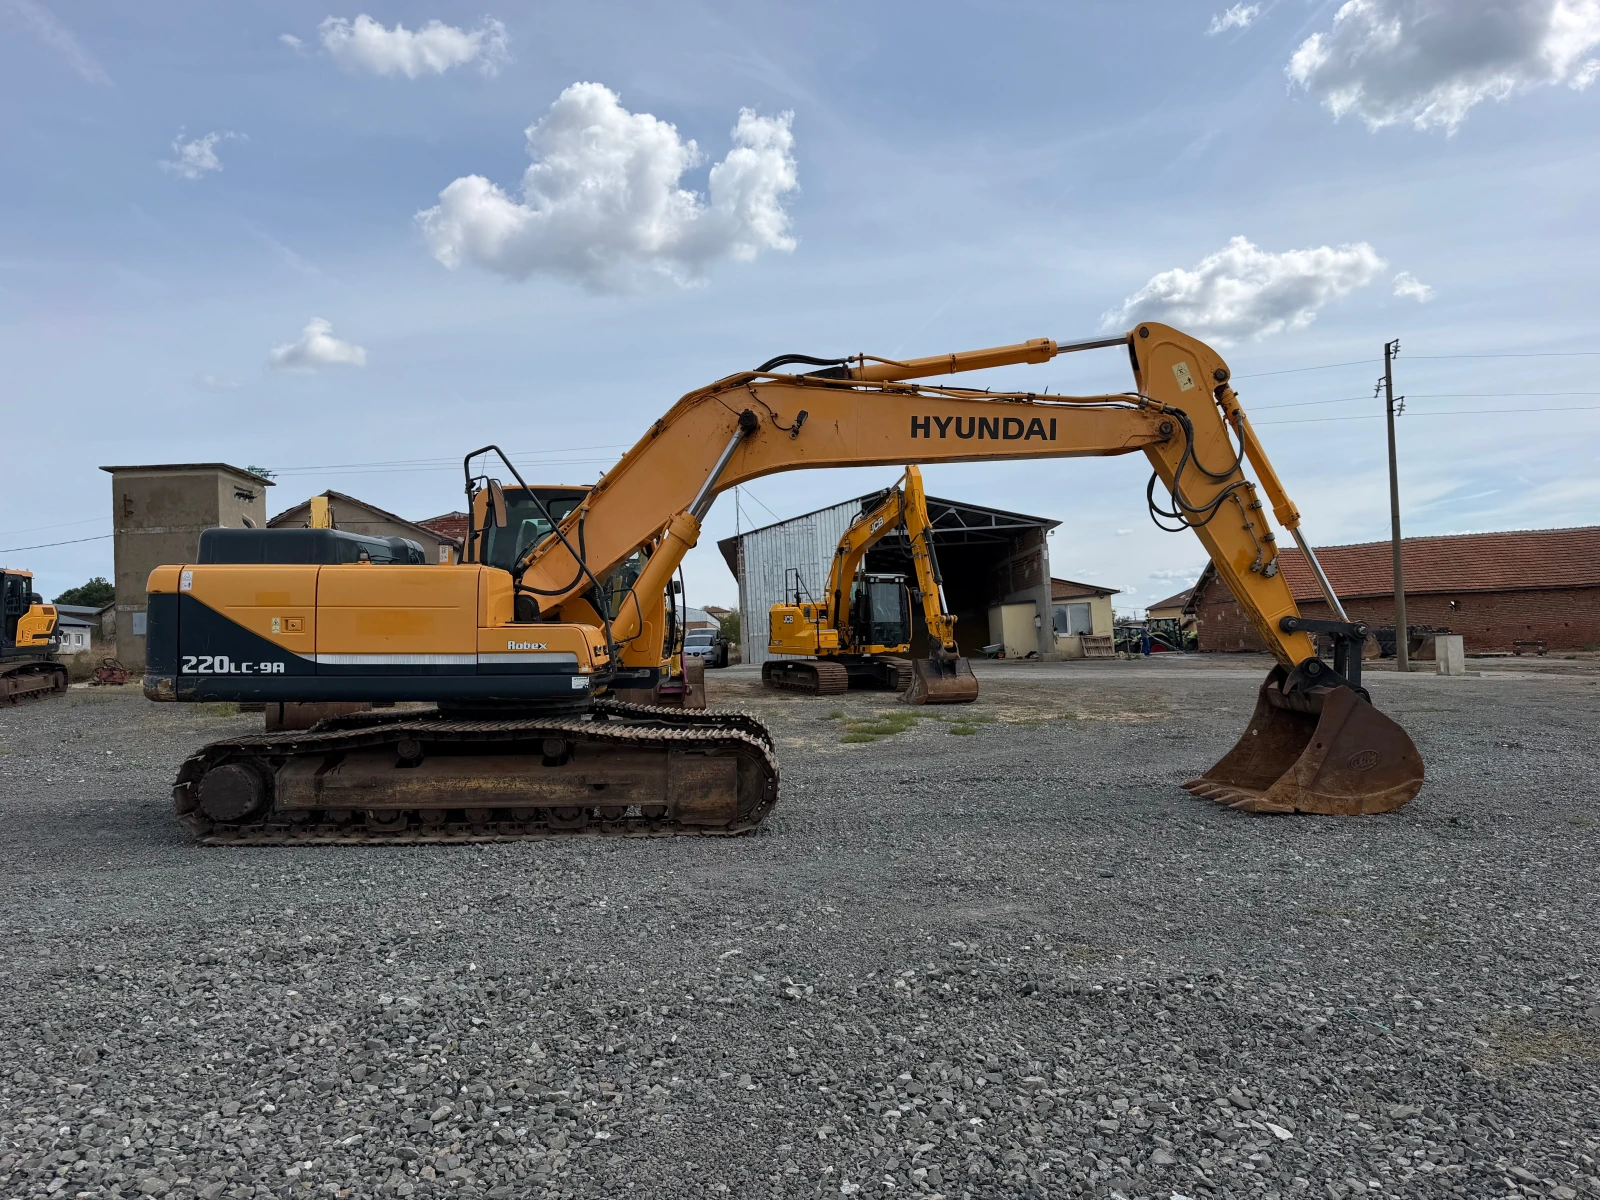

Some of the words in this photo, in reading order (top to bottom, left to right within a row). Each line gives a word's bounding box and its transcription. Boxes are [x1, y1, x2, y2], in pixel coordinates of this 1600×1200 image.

[911, 416, 1056, 440] HYUNDAI
[871, 516, 884, 534] JCB
[783, 615, 794, 624] JCB
[507, 640, 548, 650] Robex
